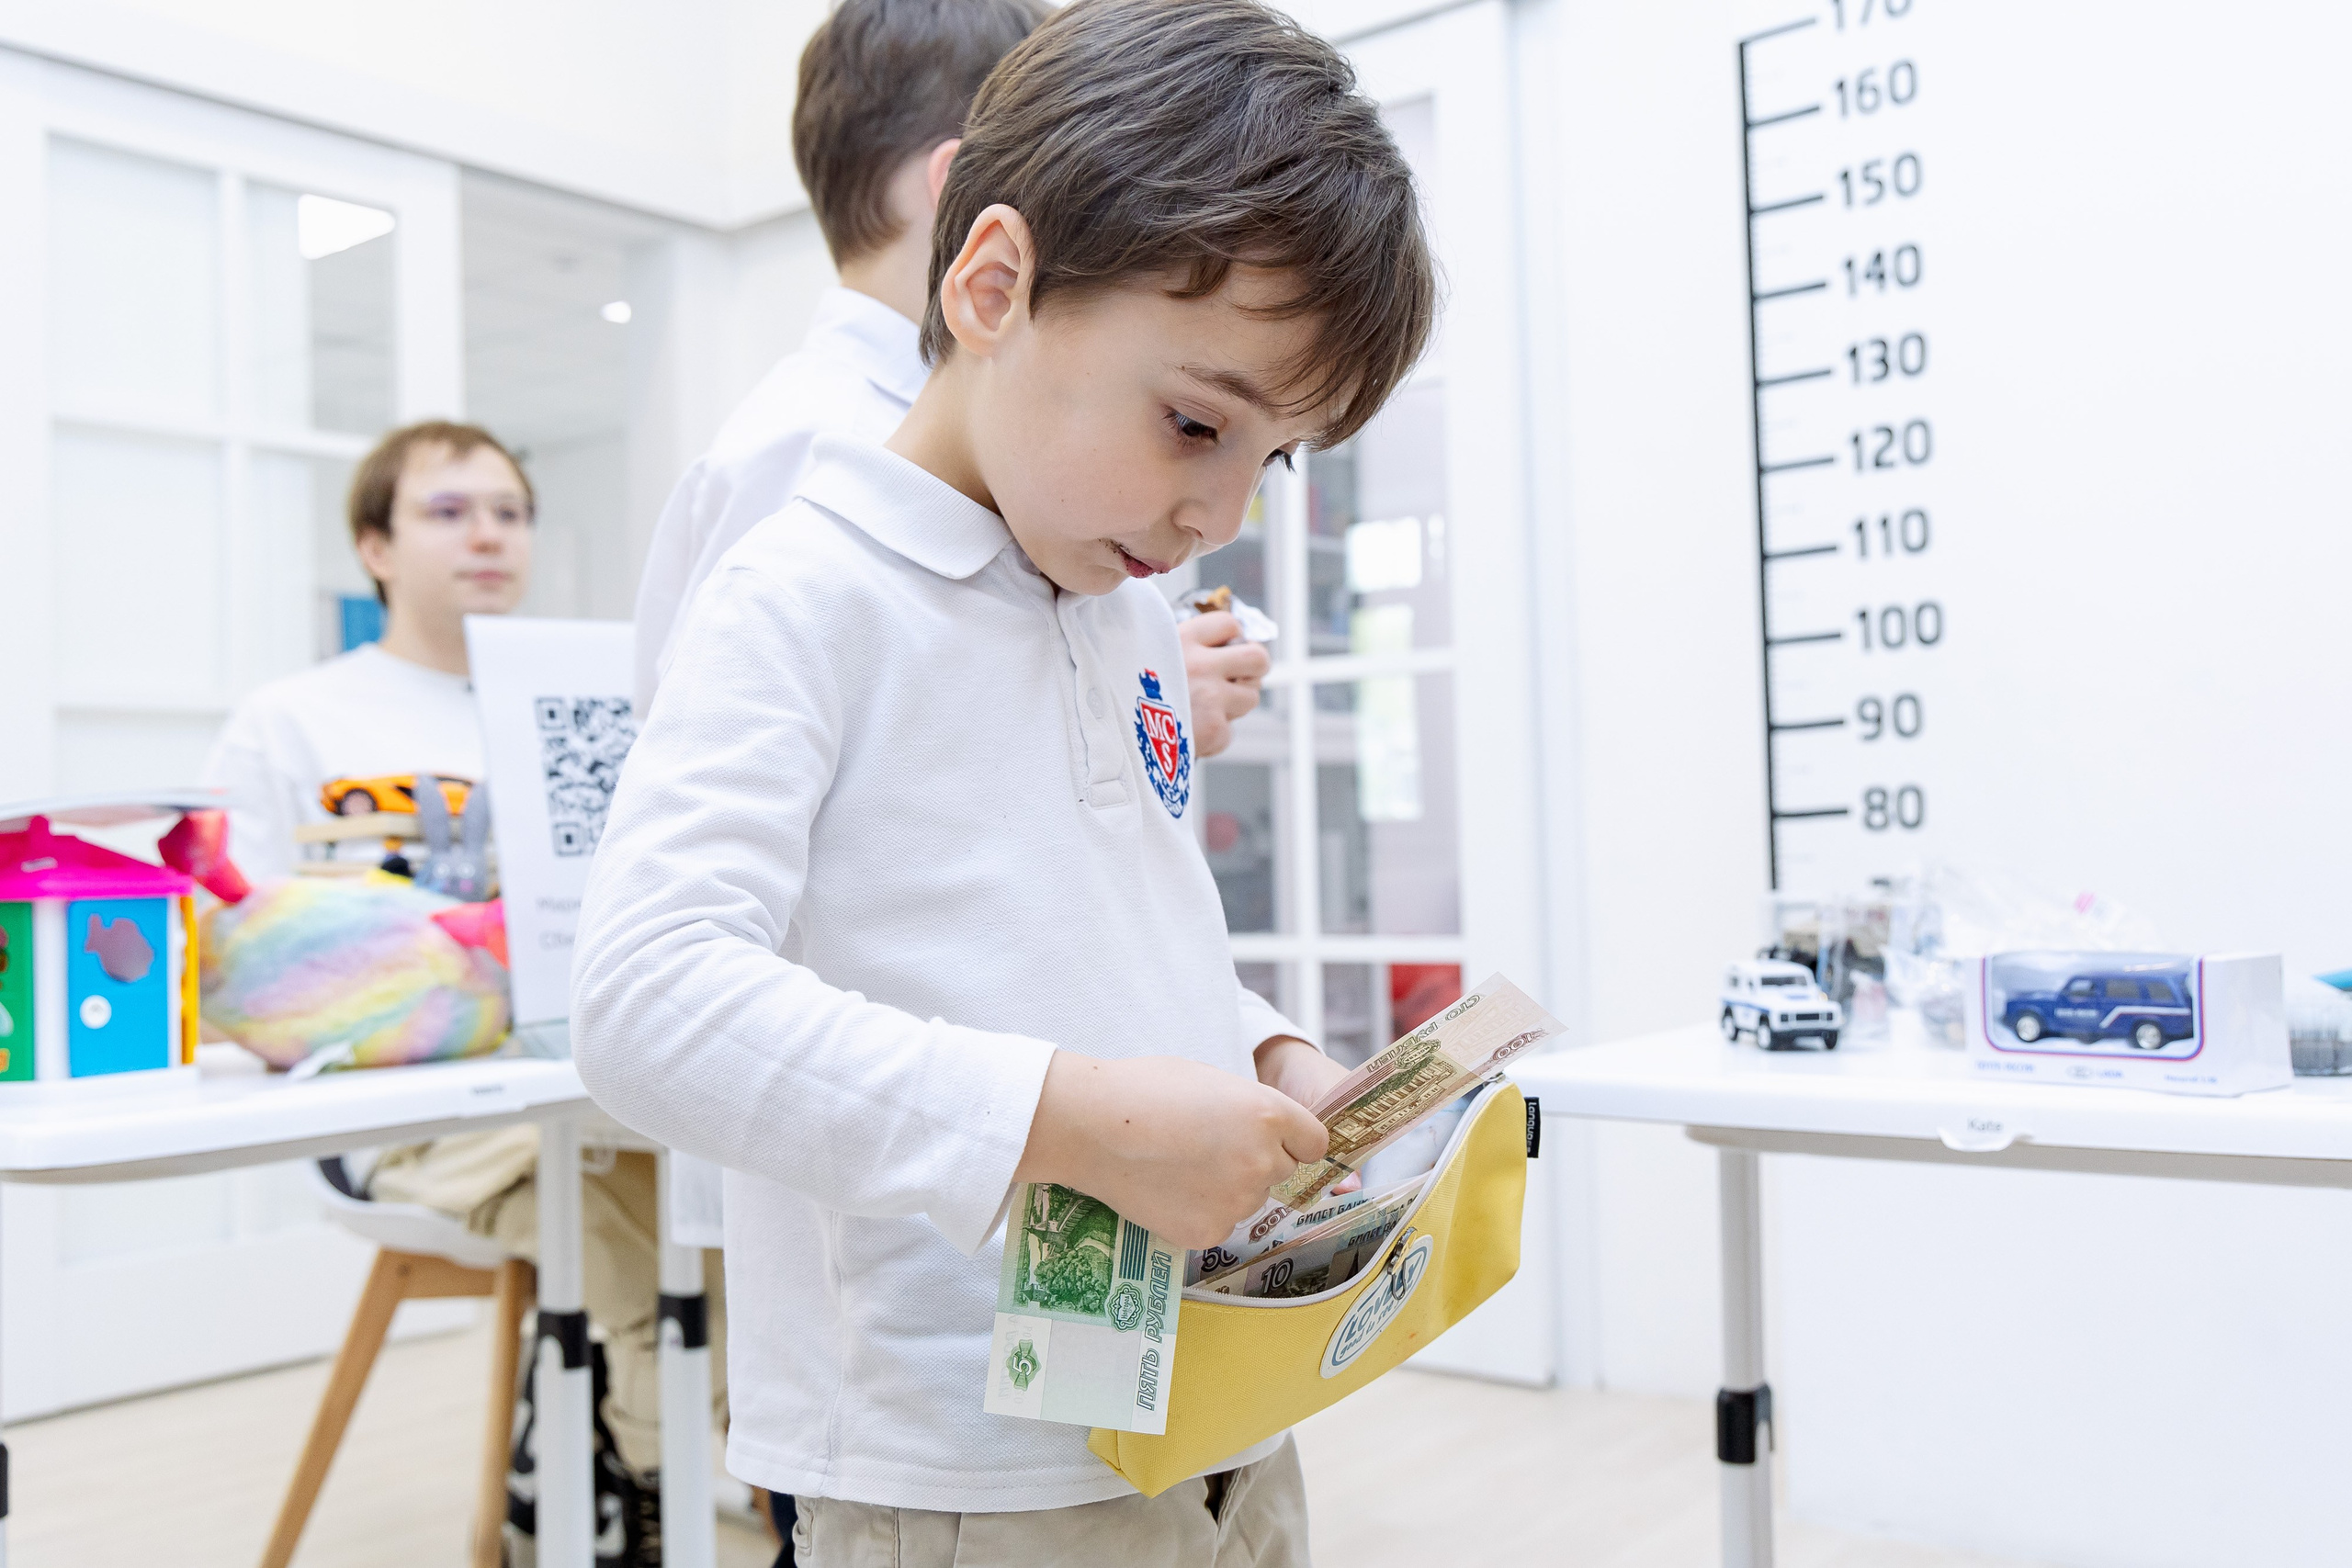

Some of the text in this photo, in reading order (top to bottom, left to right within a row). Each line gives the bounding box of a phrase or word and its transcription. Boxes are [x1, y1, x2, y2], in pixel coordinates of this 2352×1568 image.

[1833, 59, 1917, 118] 160
[1838, 152, 1921, 209] 150
[1844, 243, 1921, 297] 140
[1849, 332, 1928, 385] 130
[1851, 419, 1933, 472] 120
[1854, 508, 1930, 560] 110
[1858, 601, 1943, 651] 100
[1143, 708, 1177, 745] MC
[1857, 693, 1921, 741] 90
[1160, 743, 1173, 774] S
[1863, 785, 1925, 831] 80
[1444, 994, 1482, 1021] СТО
[1493, 1032, 1533, 1060] 100
[1967, 1117, 2004, 1134] Kate
[1250, 1206, 1290, 1239] 100
[1296, 1206, 1335, 1226] БИЛЕТ
[1261, 1258, 1295, 1295] 10
[1136, 1248, 1172, 1412] ПЯТЬ РУБЛЕЙ
[1012, 1351, 1034, 1376] 5
